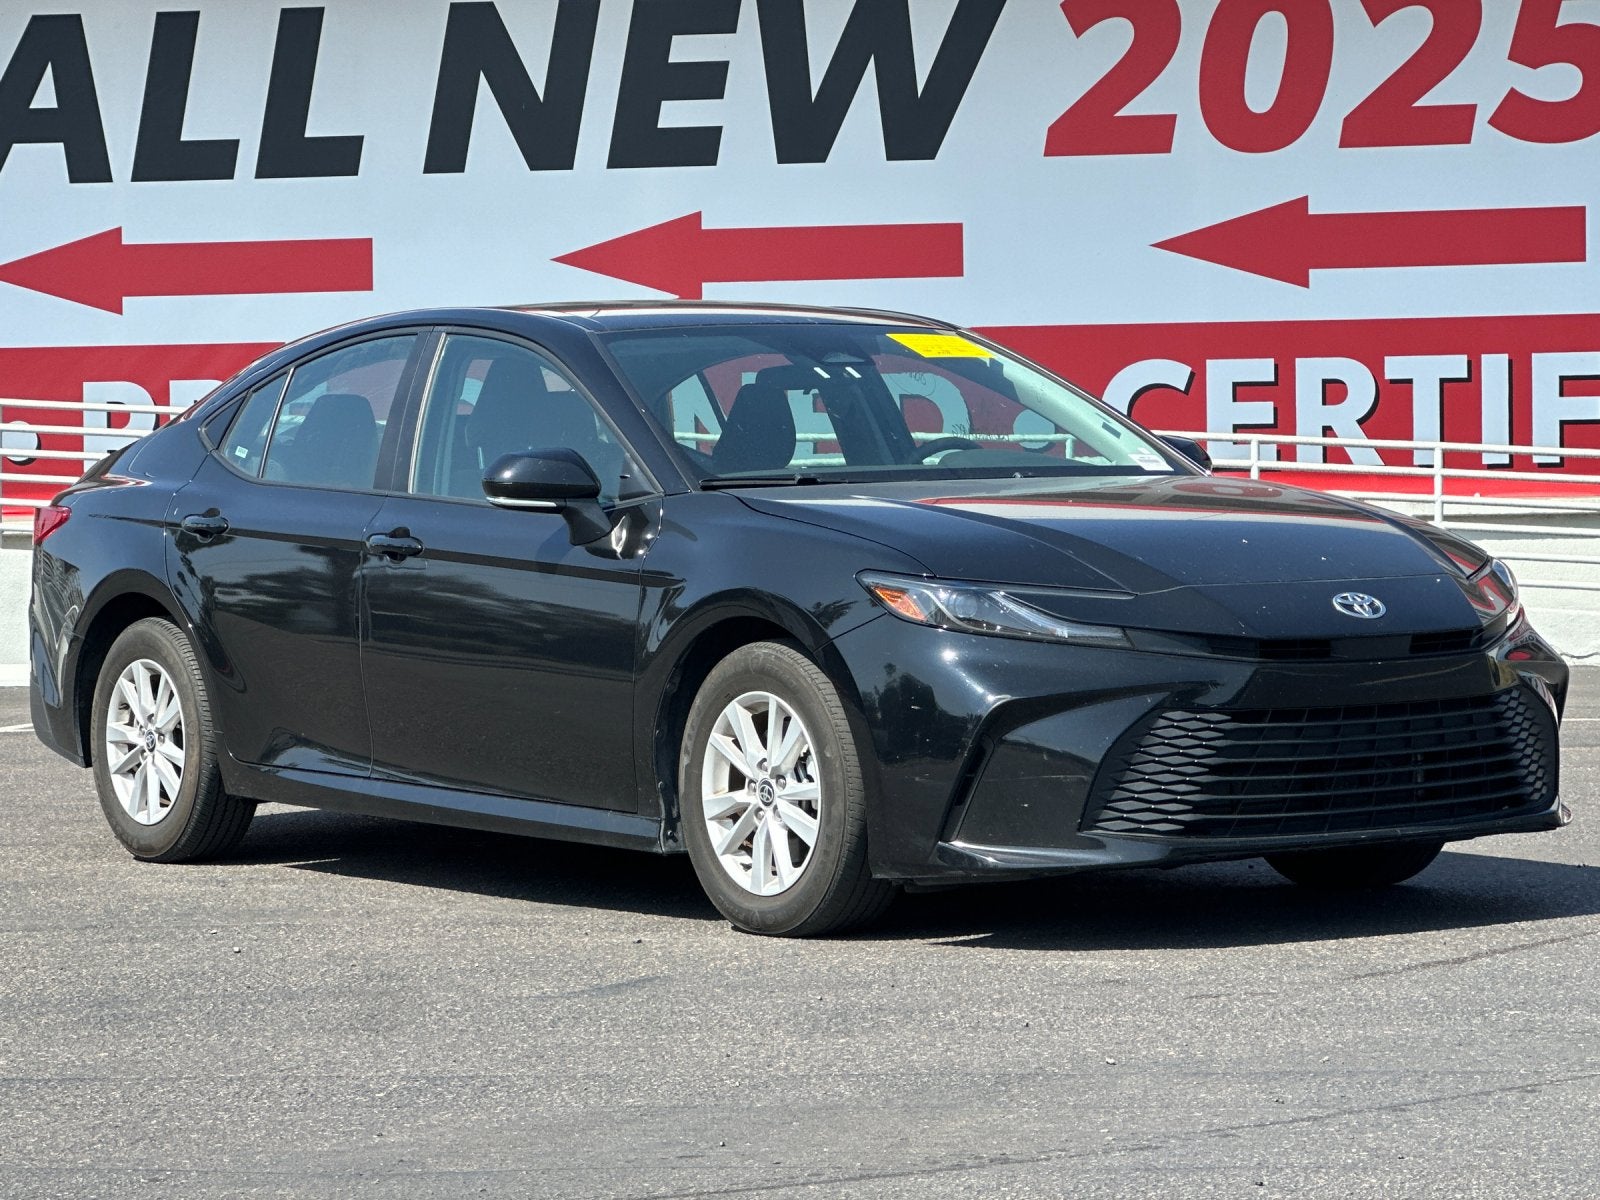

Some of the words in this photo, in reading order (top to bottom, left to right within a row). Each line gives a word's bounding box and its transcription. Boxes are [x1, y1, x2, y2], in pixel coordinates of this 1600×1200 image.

[0, 5, 365, 184] ALL
[423, 0, 1004, 174] NEW
[1044, 0, 1600, 157] 2025
